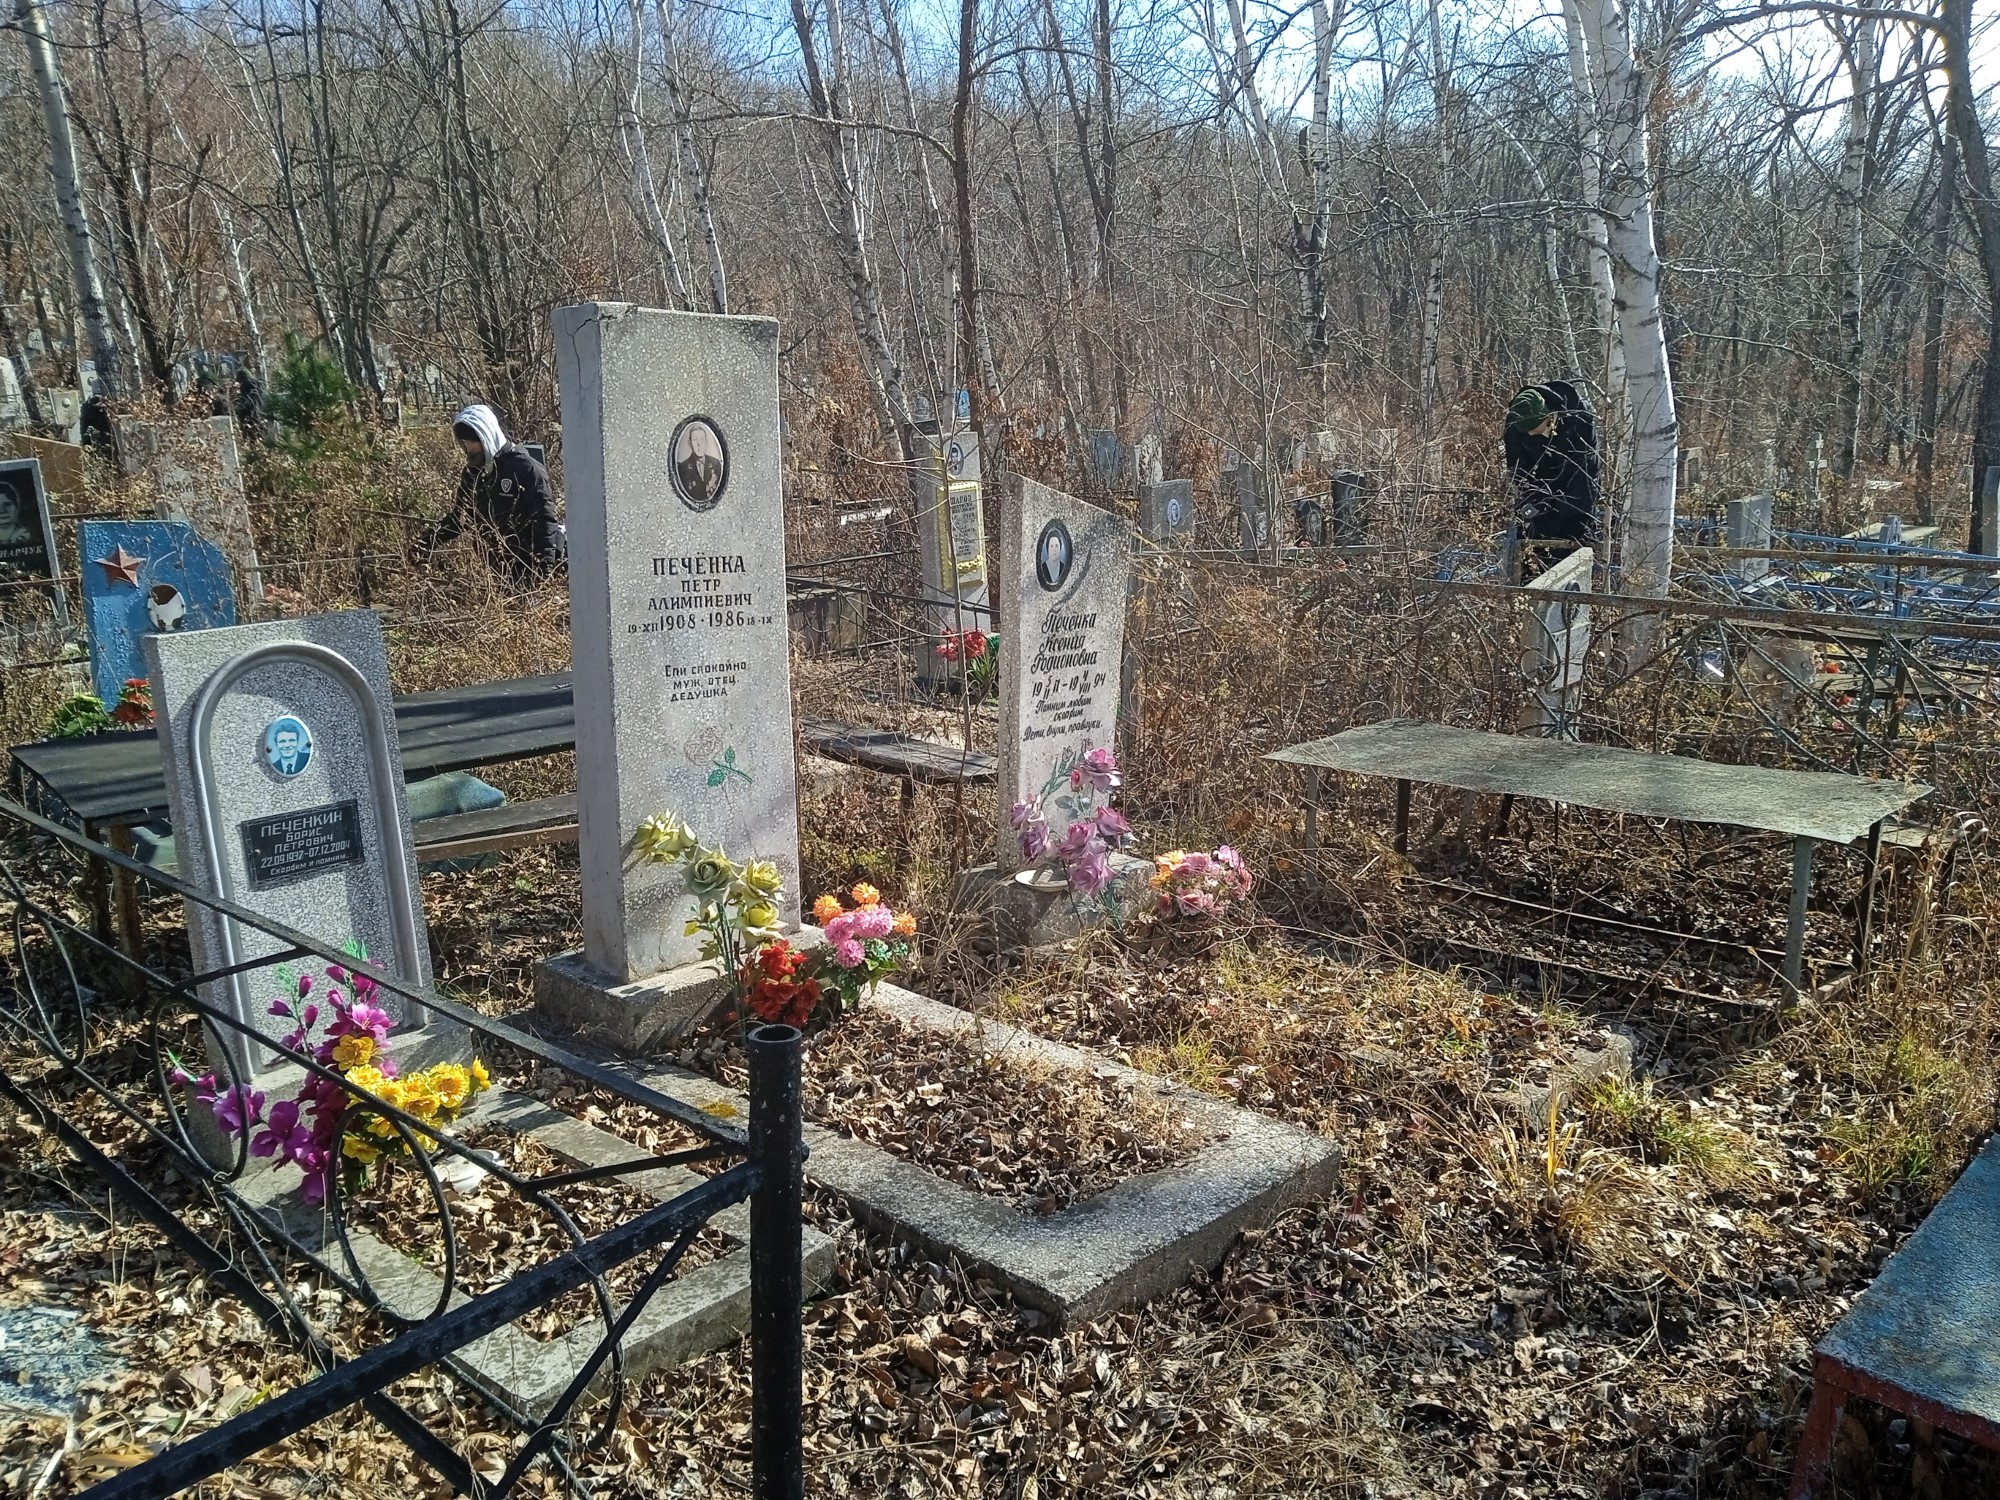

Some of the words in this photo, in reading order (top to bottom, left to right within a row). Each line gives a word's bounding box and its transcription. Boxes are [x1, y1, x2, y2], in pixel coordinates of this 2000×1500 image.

[652, 552, 746, 576] ПЕЧЁНКА
[681, 578, 721, 592] ПЕТР
[648, 593, 752, 611] АЛИМПИЕВИЧ
[1039, 633, 1086, 653] Ксения
[1030, 648, 1098, 675] Родионовна
[670, 687, 728, 702] ДЕДУШКА
[261, 811, 343, 838] ПЕЧЕНКИН
[274, 833, 334, 854] ПЕТРОВИЧ
[286, 827, 323, 842] БОРИС
[270, 862, 307, 876] Скорбим
